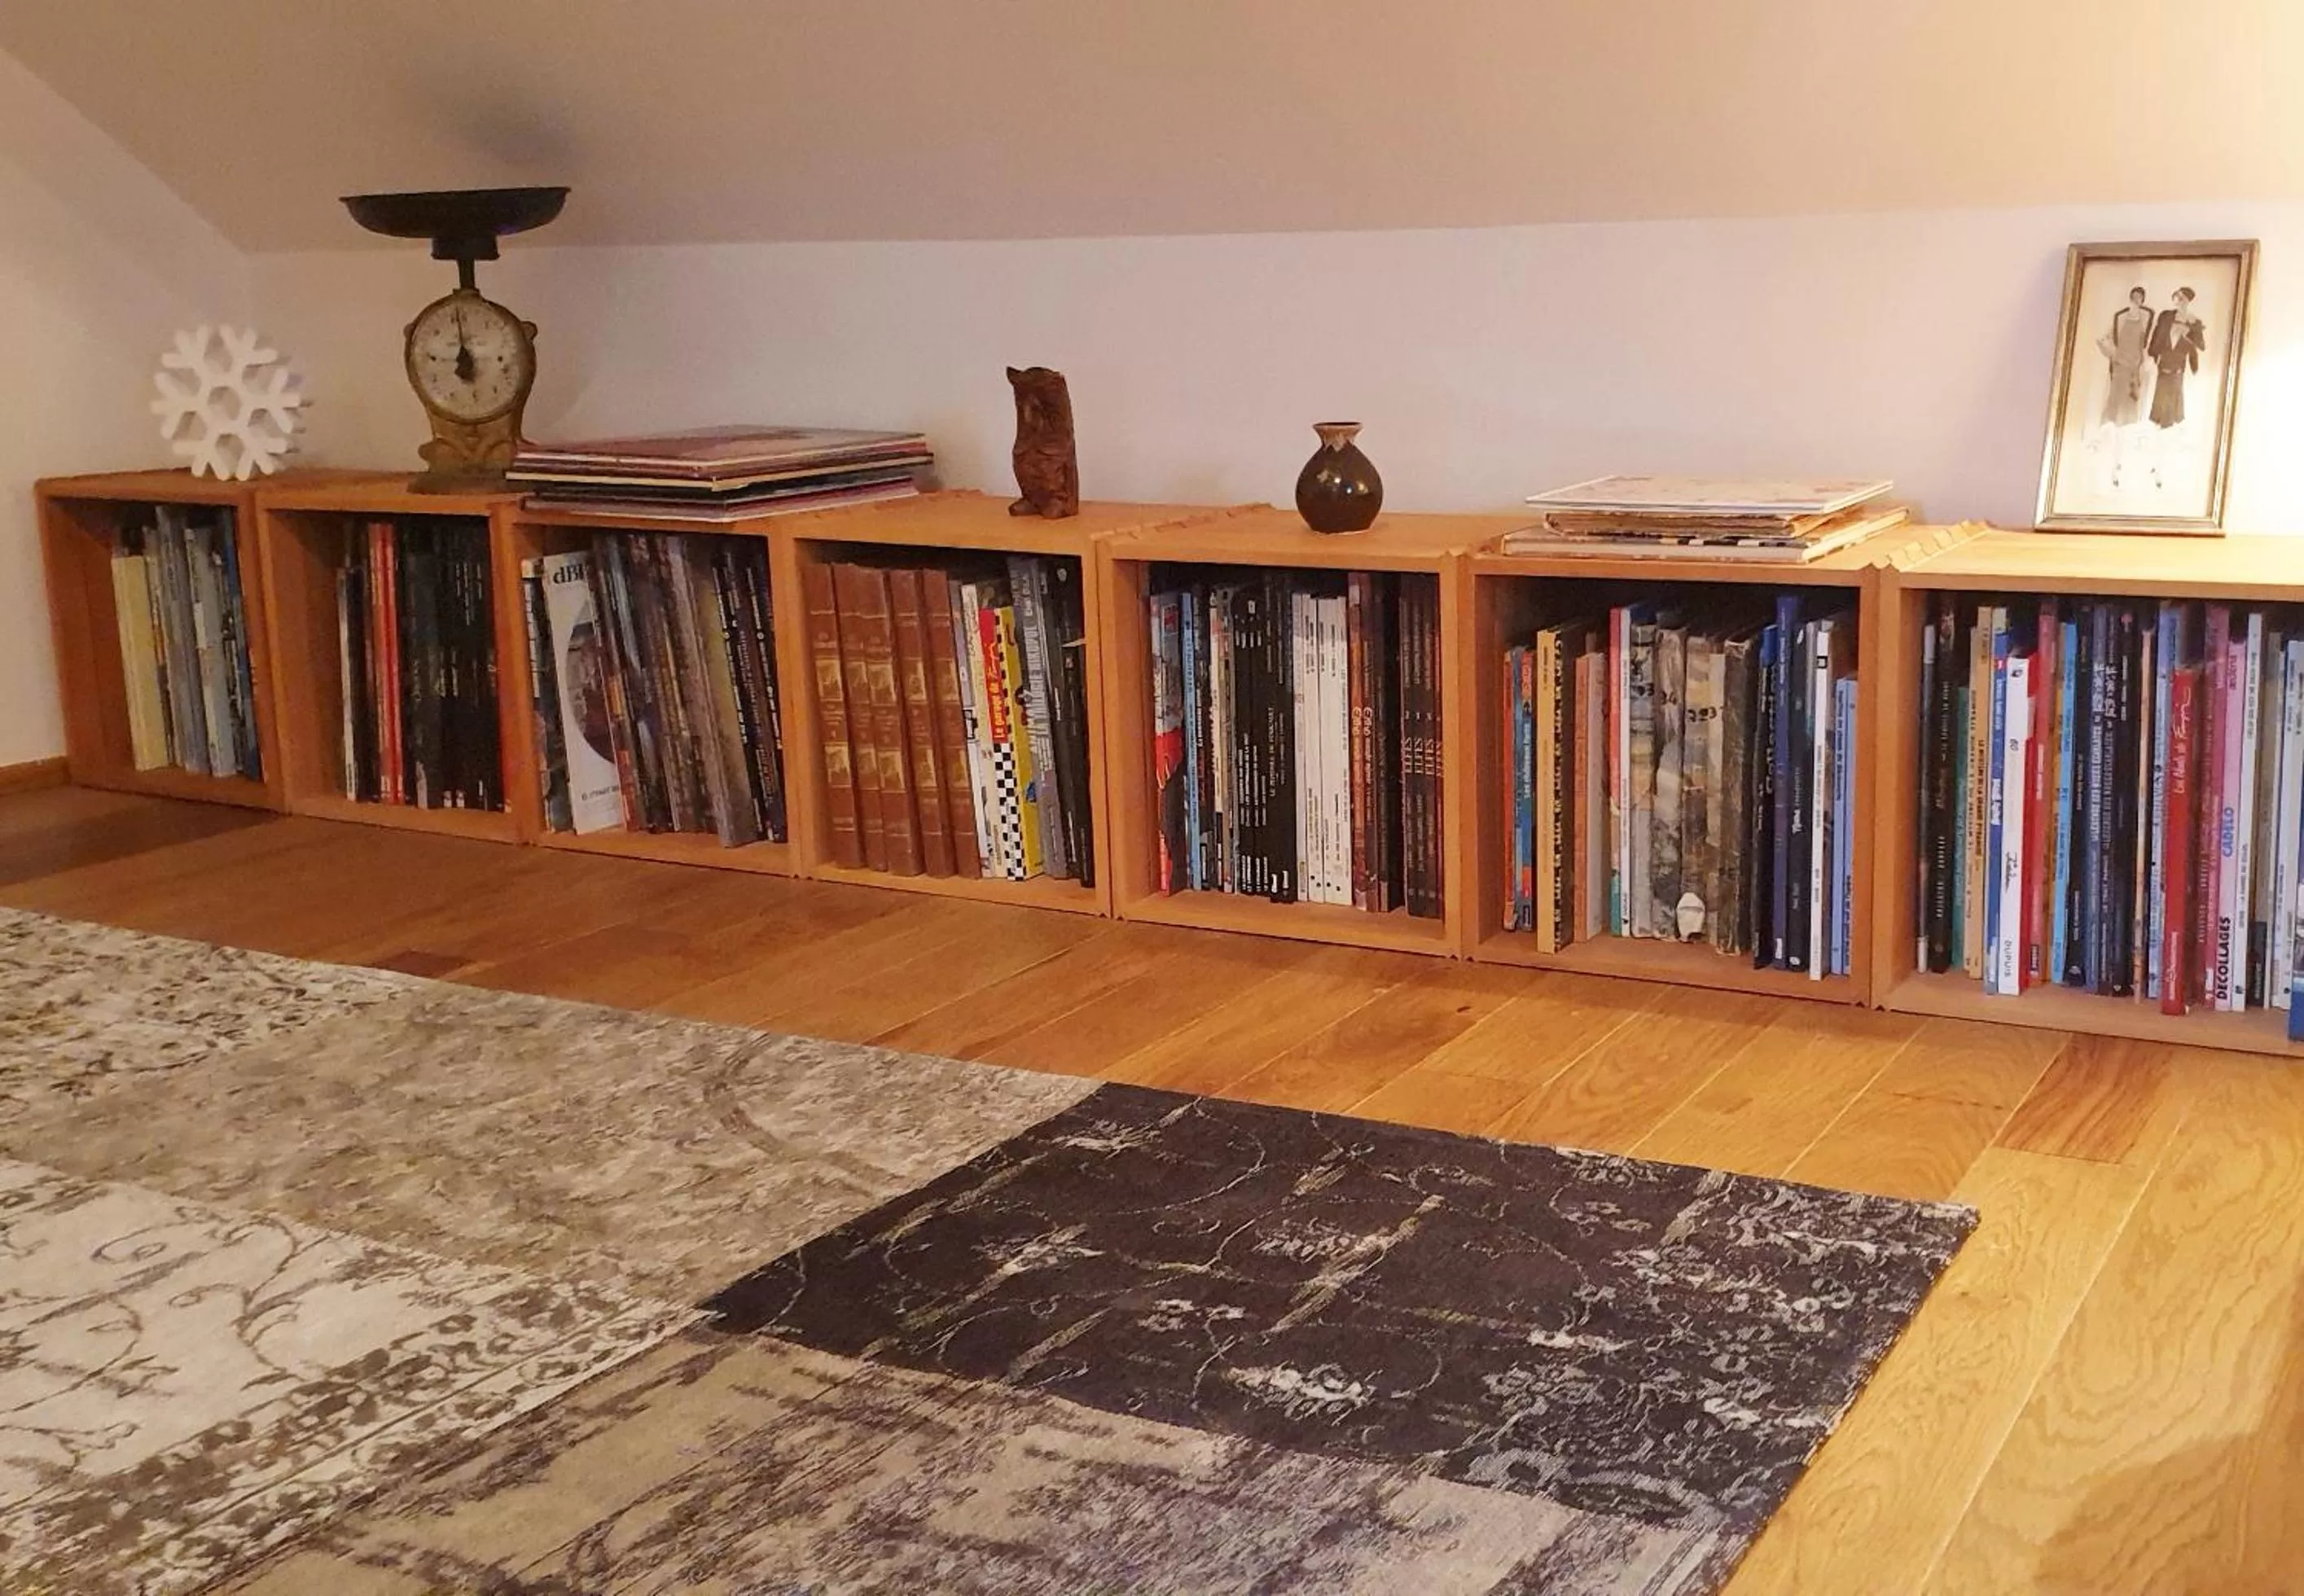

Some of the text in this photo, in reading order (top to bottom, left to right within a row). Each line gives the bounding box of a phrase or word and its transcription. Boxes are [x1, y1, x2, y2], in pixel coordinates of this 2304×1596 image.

[990, 682, 1001, 693] de
[991, 695, 1005, 726] garage
[994, 728, 1005, 737] Le
[1522, 723, 1531, 744] forts
[1404, 737, 1413, 774] ELFES
[1414, 738, 1423, 774] ELFES
[1424, 739, 1434, 775] ELFES
[1523, 784, 1531, 798] Les
[2003, 940, 2012, 978] DUPUIS
[2216, 916, 2231, 1000] DECOLLAGES
